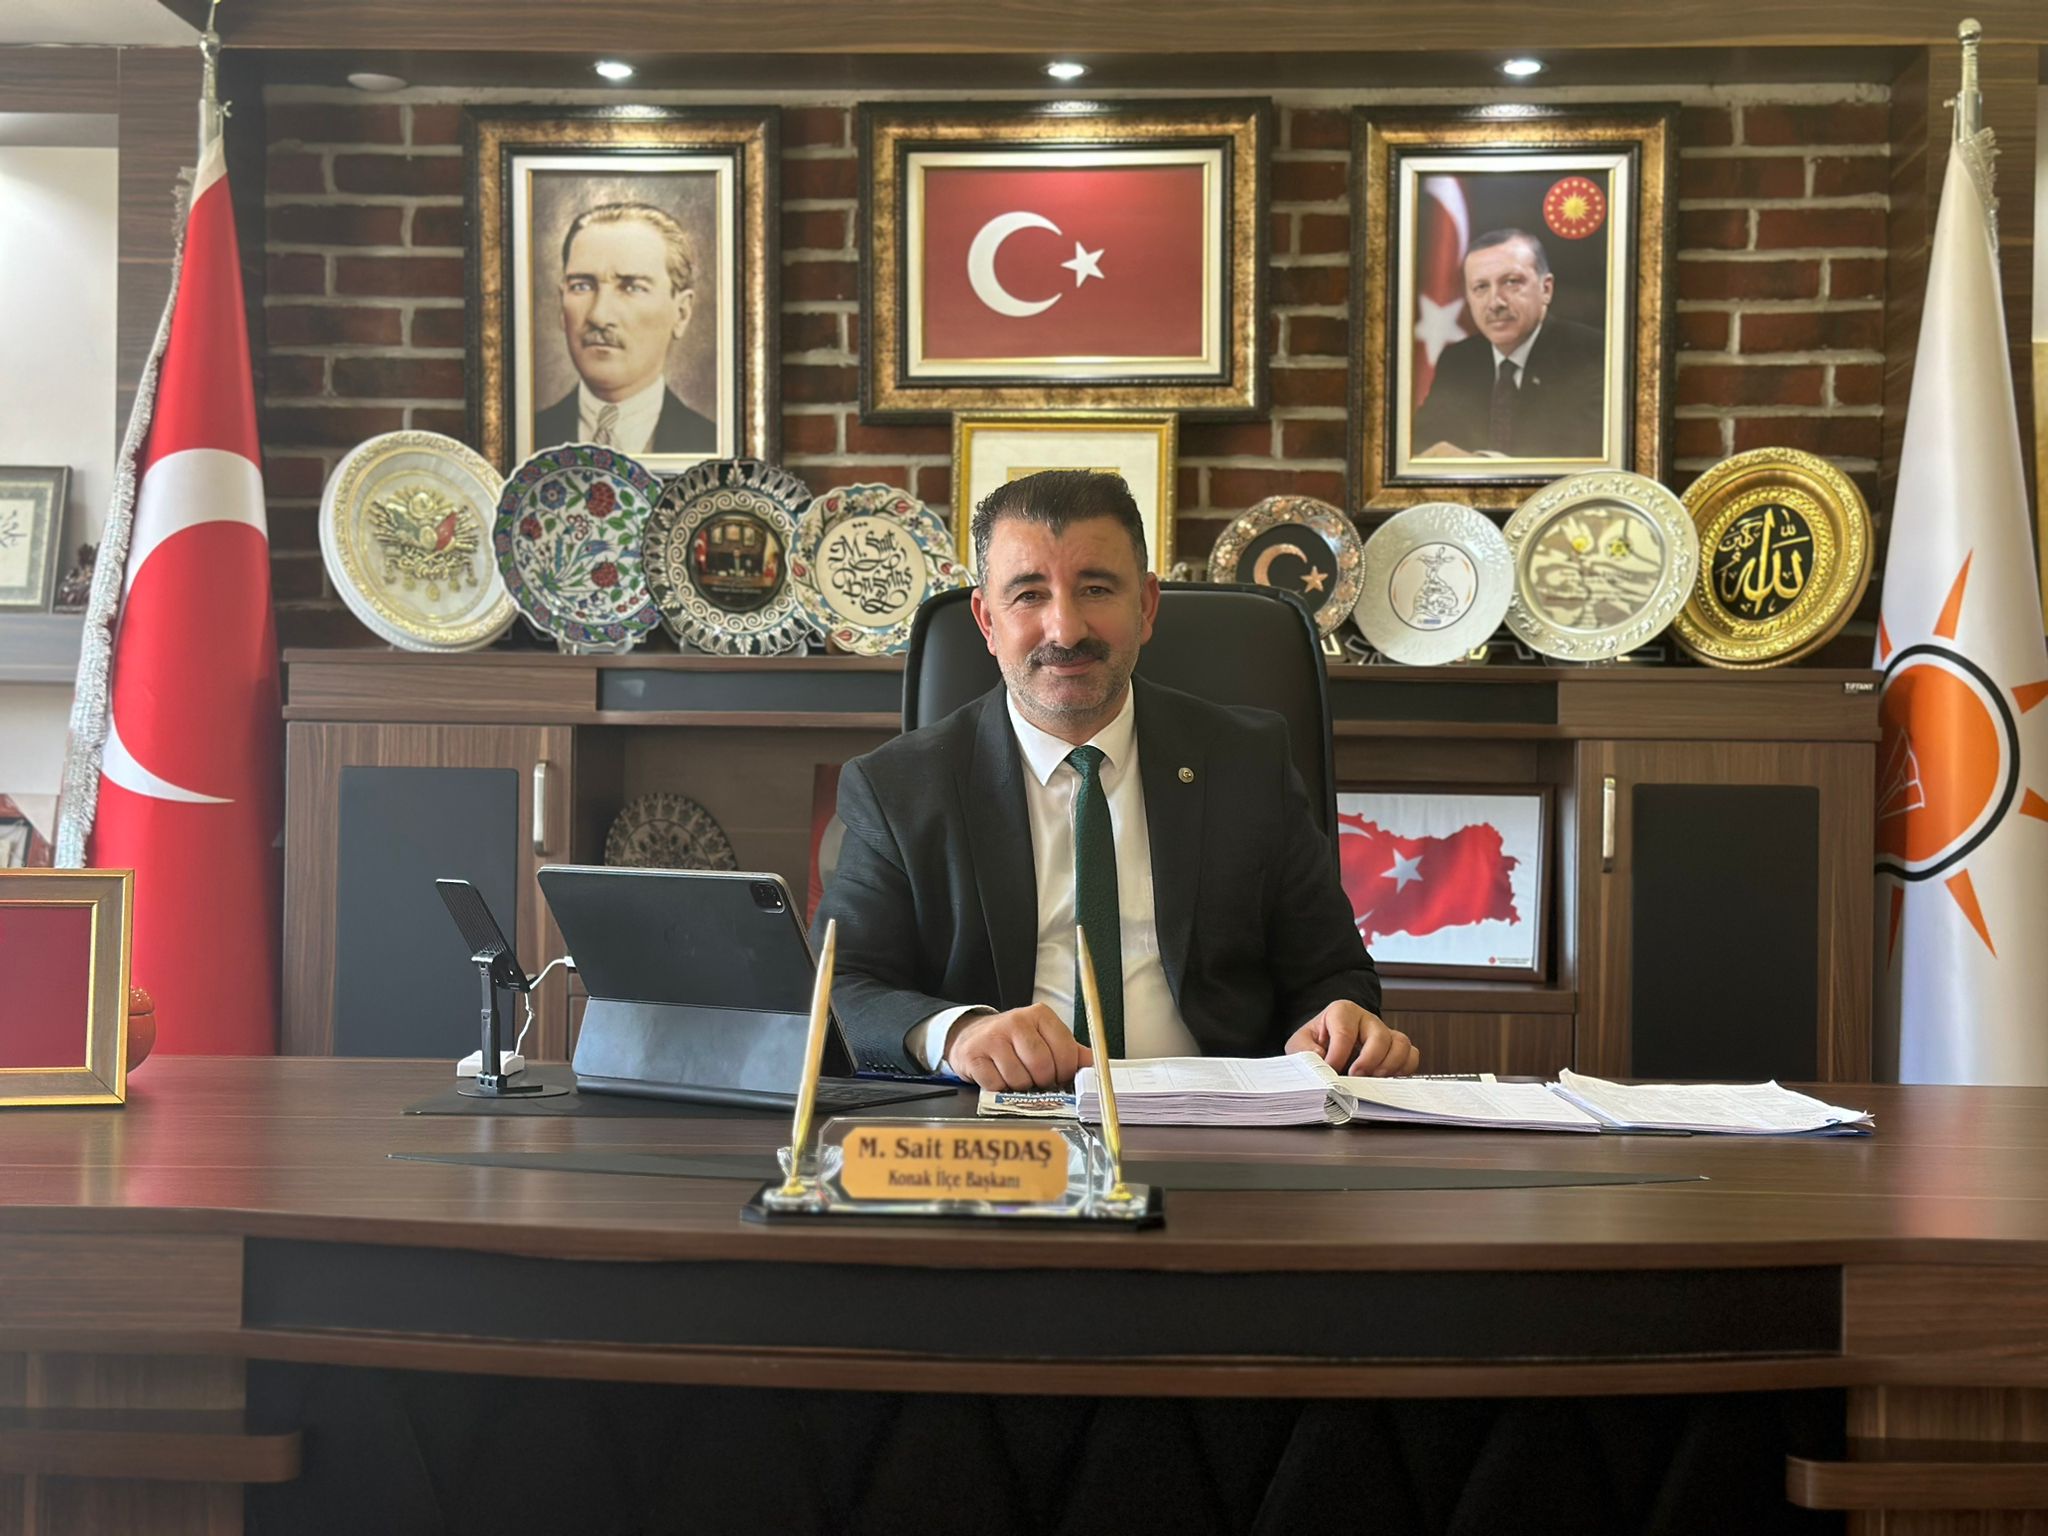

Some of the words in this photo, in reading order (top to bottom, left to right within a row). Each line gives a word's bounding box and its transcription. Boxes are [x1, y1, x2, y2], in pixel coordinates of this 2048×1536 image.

[866, 530, 898, 556] Sait
[858, 1137, 885, 1158] M.
[895, 1137, 943, 1159] Sait
[953, 1139, 1052, 1167] BAŞDAŞ
[888, 1170, 931, 1187] Konak
[936, 1166, 961, 1191] İlçe
[966, 1172, 1020, 1192] Başkanı
